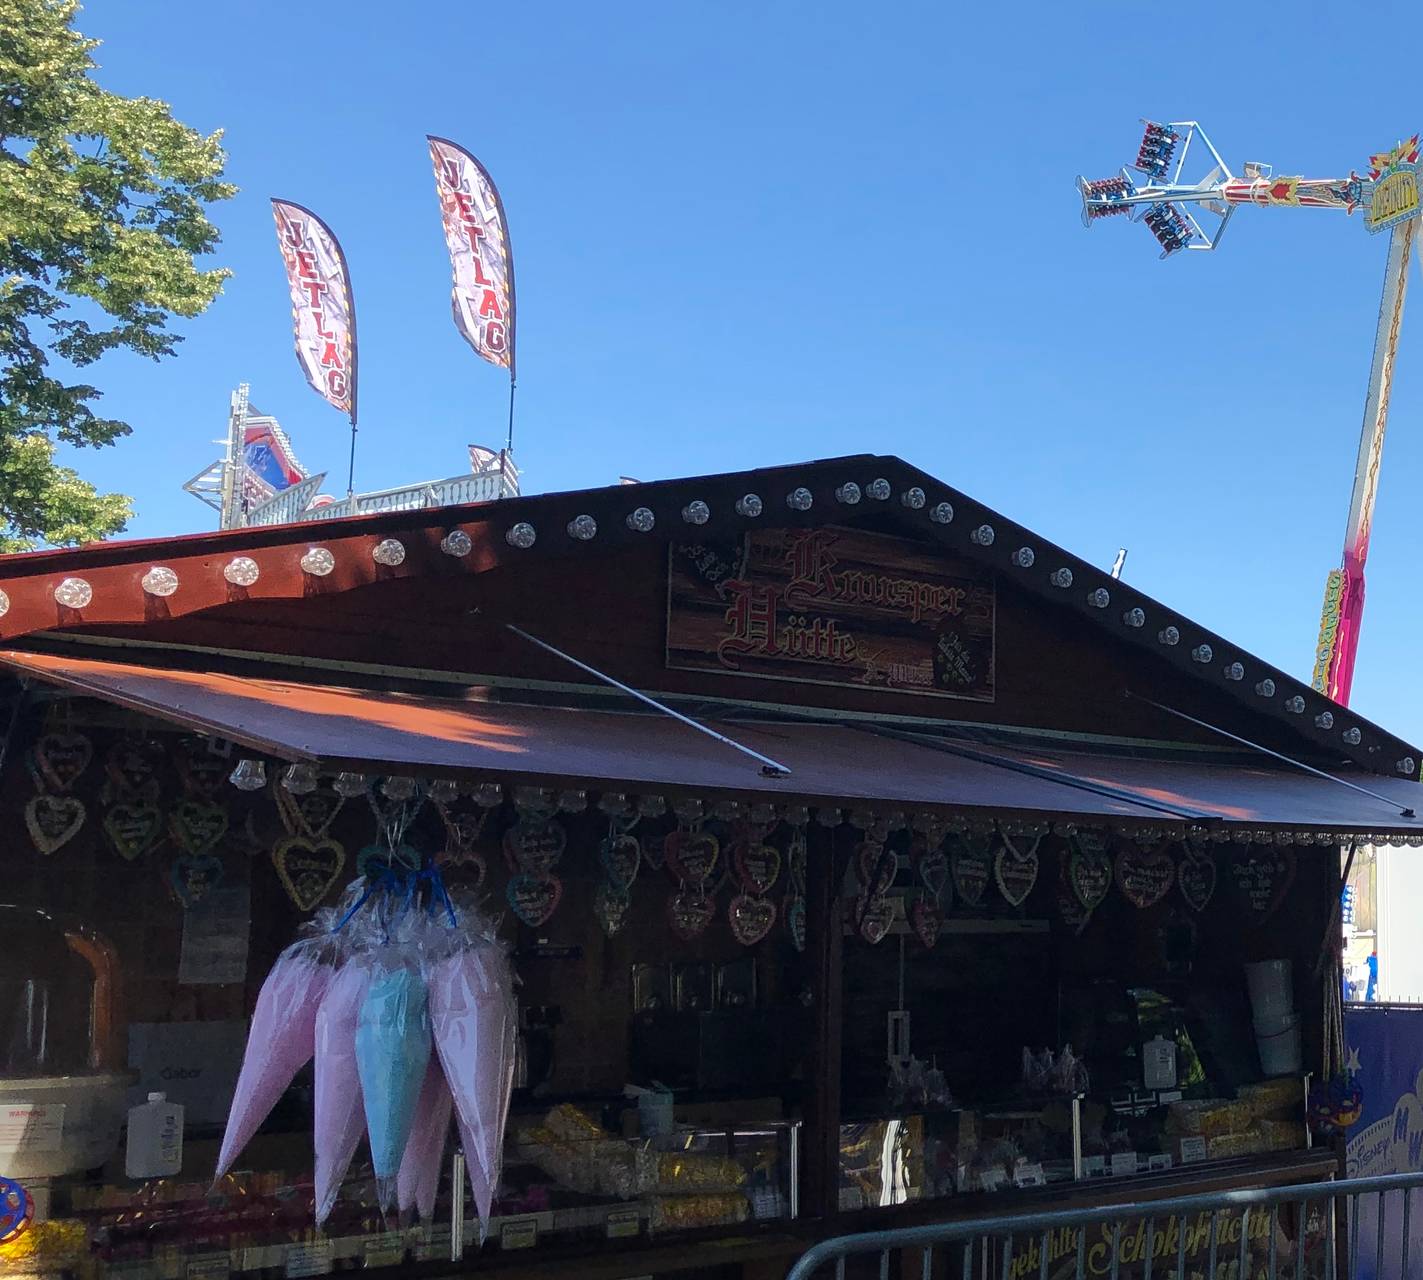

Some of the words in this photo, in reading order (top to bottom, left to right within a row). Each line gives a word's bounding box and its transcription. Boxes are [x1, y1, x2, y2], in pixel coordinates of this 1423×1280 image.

[285, 220, 346, 398] JETLAG
[444, 158, 505, 352] JETLAG
[717, 578, 857, 669] Hütte
[784, 530, 966, 623] Knusper
